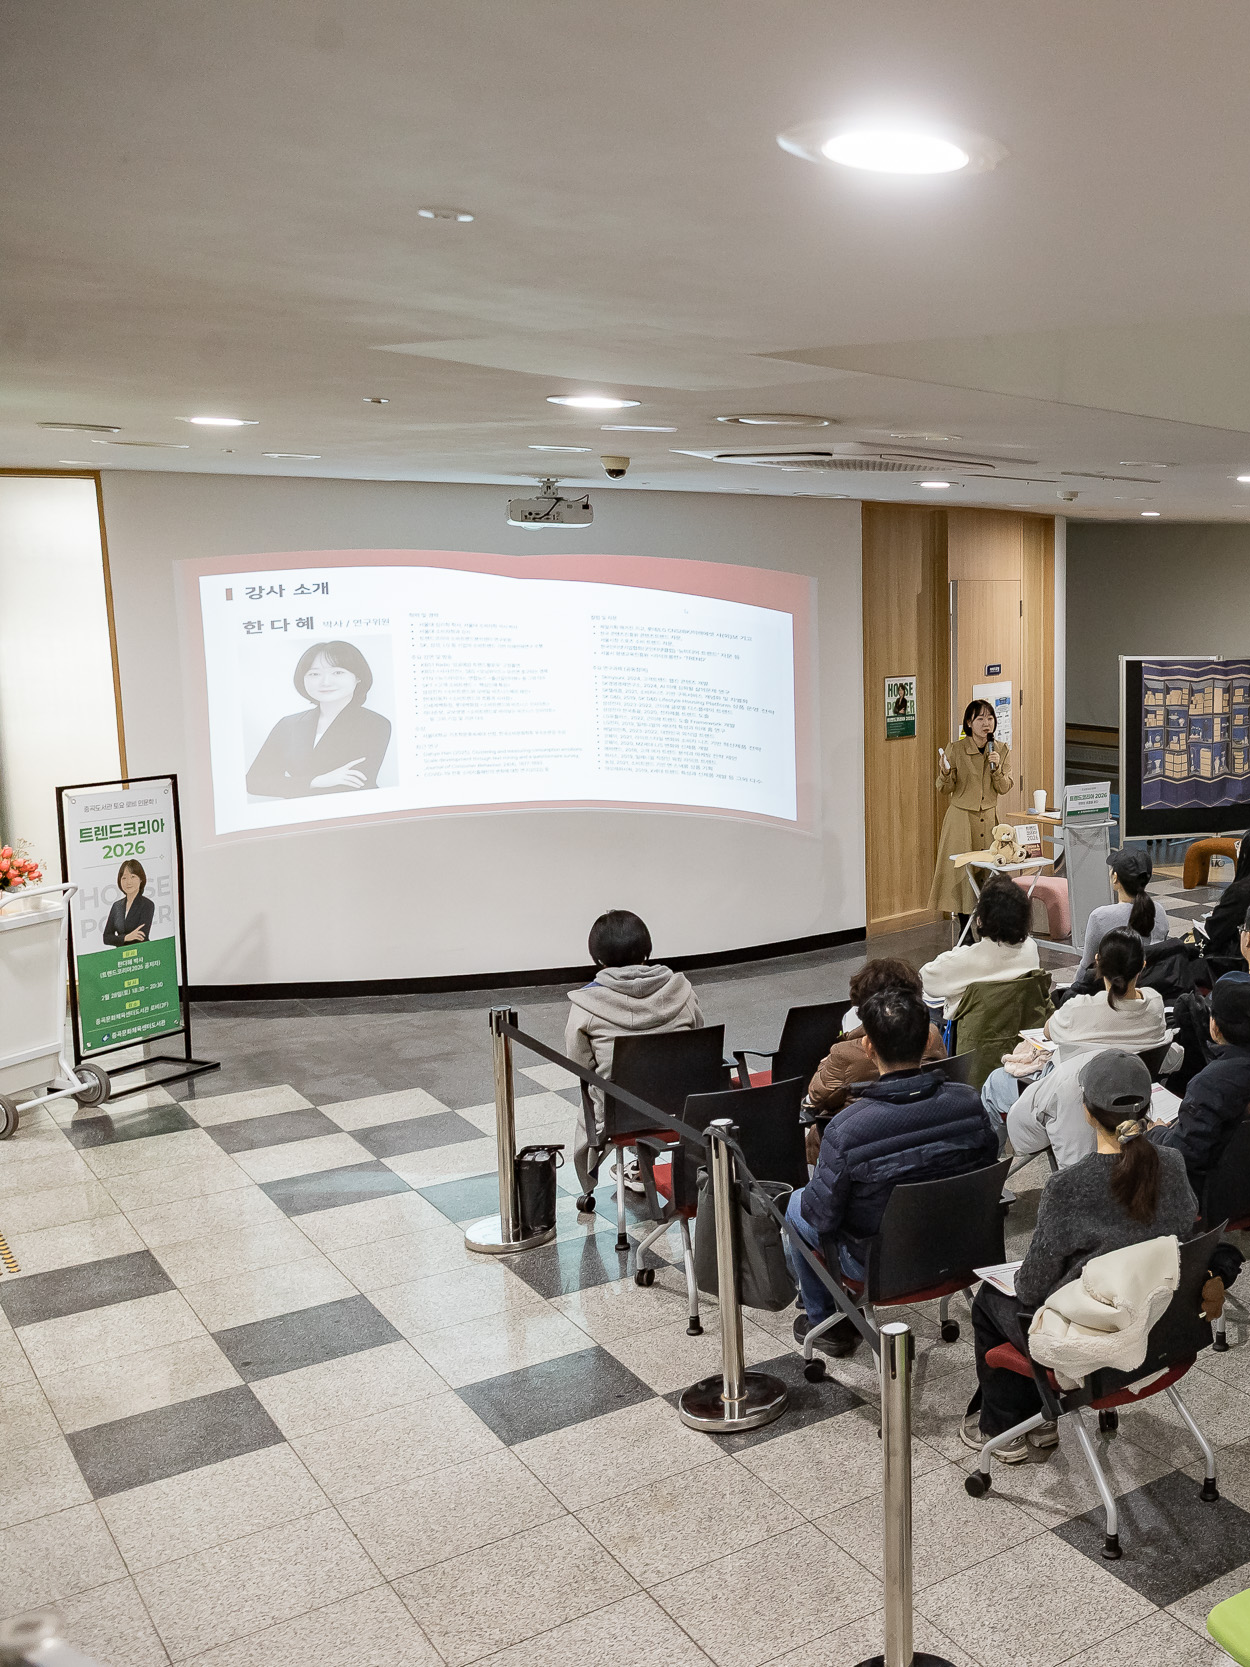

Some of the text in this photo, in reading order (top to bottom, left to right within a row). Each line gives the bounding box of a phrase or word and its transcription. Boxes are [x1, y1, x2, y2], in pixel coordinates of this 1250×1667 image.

[245, 582, 329, 600] 강사 소개
[353, 618, 390, 626] 연구위원
[888, 682, 913, 697] HOSE
[80, 818, 164, 843] 트렌드코리아
[102, 840, 145, 859] 2026
[79, 875, 170, 910] HOSE
